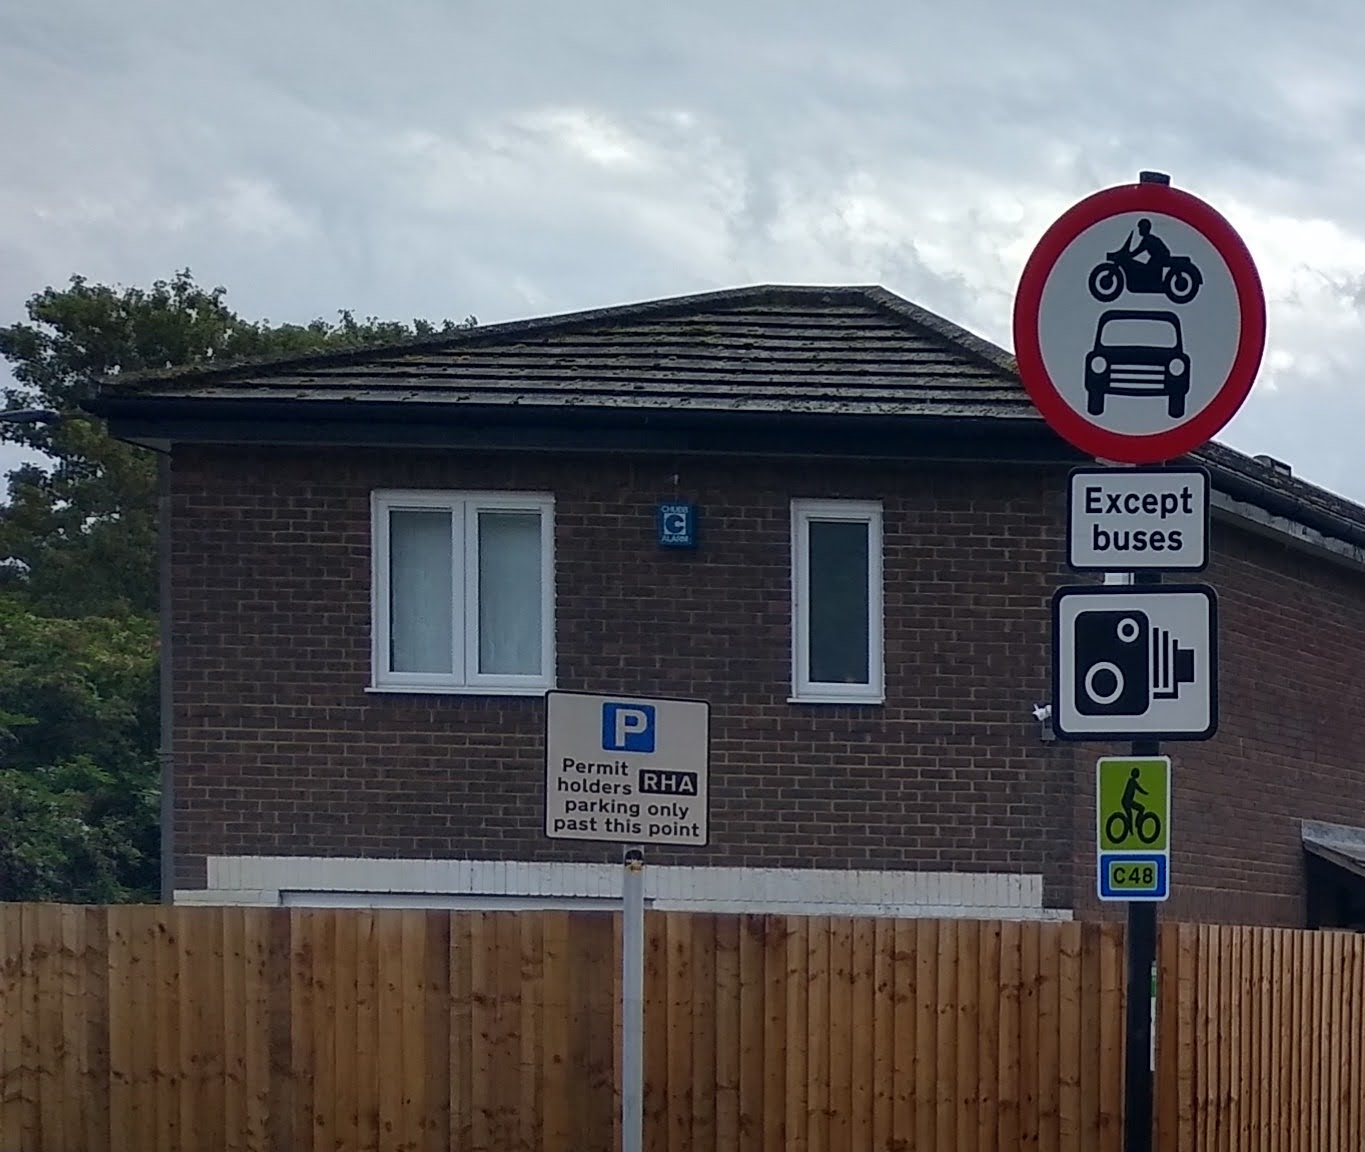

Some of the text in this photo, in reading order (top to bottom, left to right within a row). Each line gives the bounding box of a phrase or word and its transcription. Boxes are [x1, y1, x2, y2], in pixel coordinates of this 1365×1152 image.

[1085, 486, 1193, 519] Except
[1093, 523, 1183, 551] buses
[615, 708, 648, 747] P
[562, 757, 629, 776] Permit
[557, 776, 632, 796] holders
[643, 773, 695, 793] RHA
[565, 798, 690, 820] parking only
[554, 817, 700, 838] past this point
[1112, 866, 1153, 885] C48
